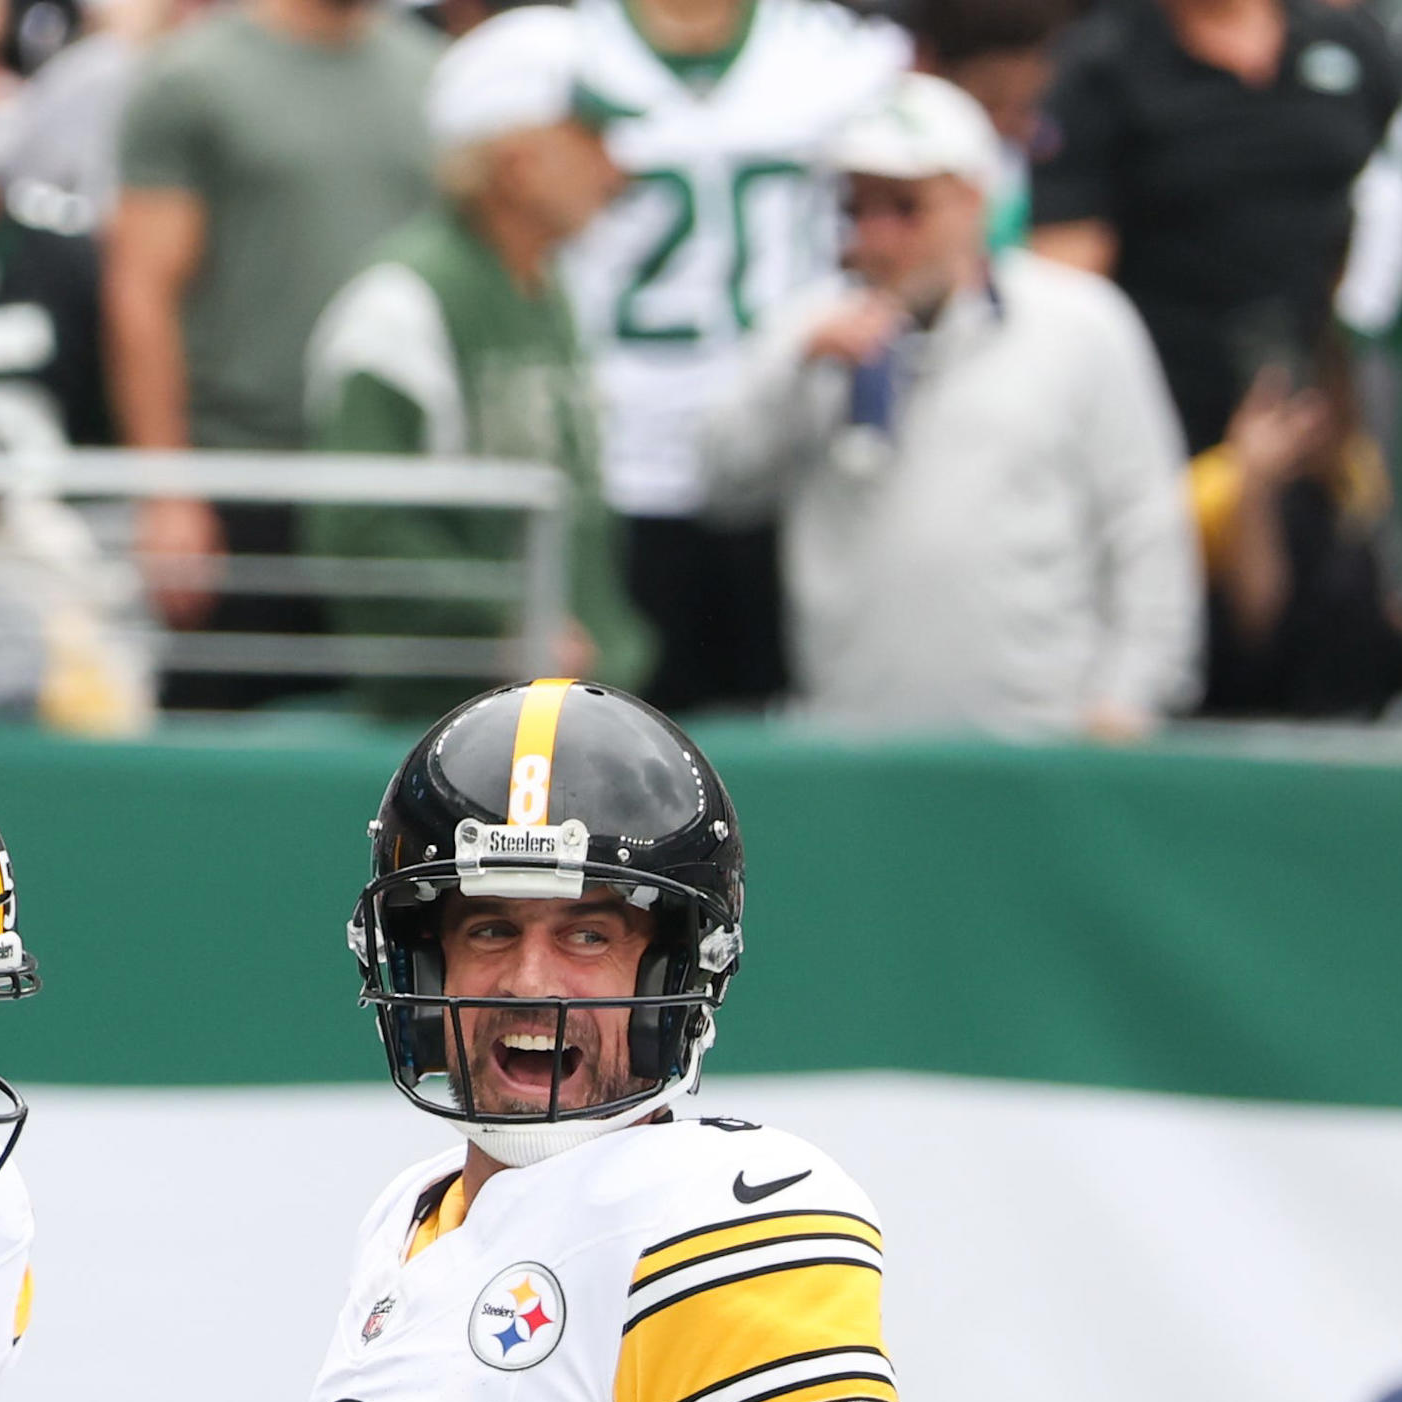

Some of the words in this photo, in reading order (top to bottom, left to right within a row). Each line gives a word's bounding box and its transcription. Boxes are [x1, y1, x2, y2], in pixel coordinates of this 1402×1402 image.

[509, 754, 548, 826] 8
[490, 830, 555, 853] Steelers
[481, 1302, 516, 1319] Steelers
